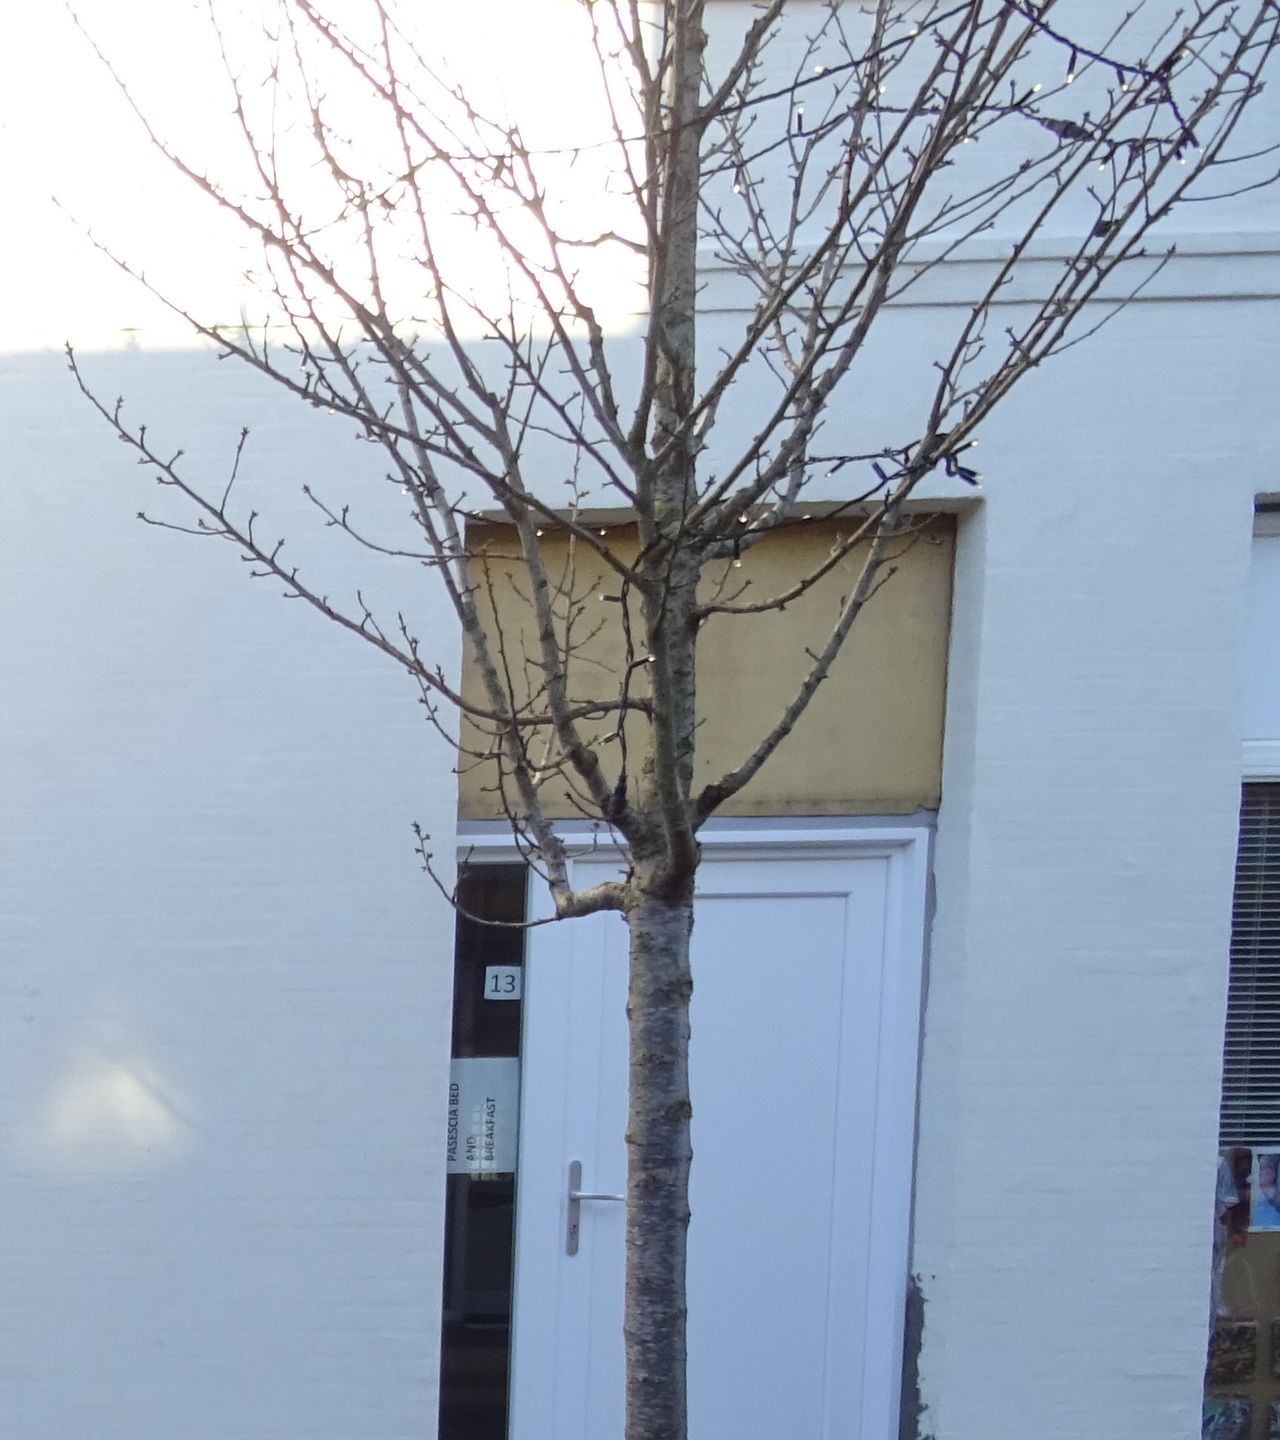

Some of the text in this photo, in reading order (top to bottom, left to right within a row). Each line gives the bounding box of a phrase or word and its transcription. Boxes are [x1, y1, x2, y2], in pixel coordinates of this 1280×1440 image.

[490, 974, 515, 993] 13
[449, 1083, 459, 1106] BED
[484, 1097, 496, 1161] BREAKFAST
[466, 1136, 476, 1161] AND
